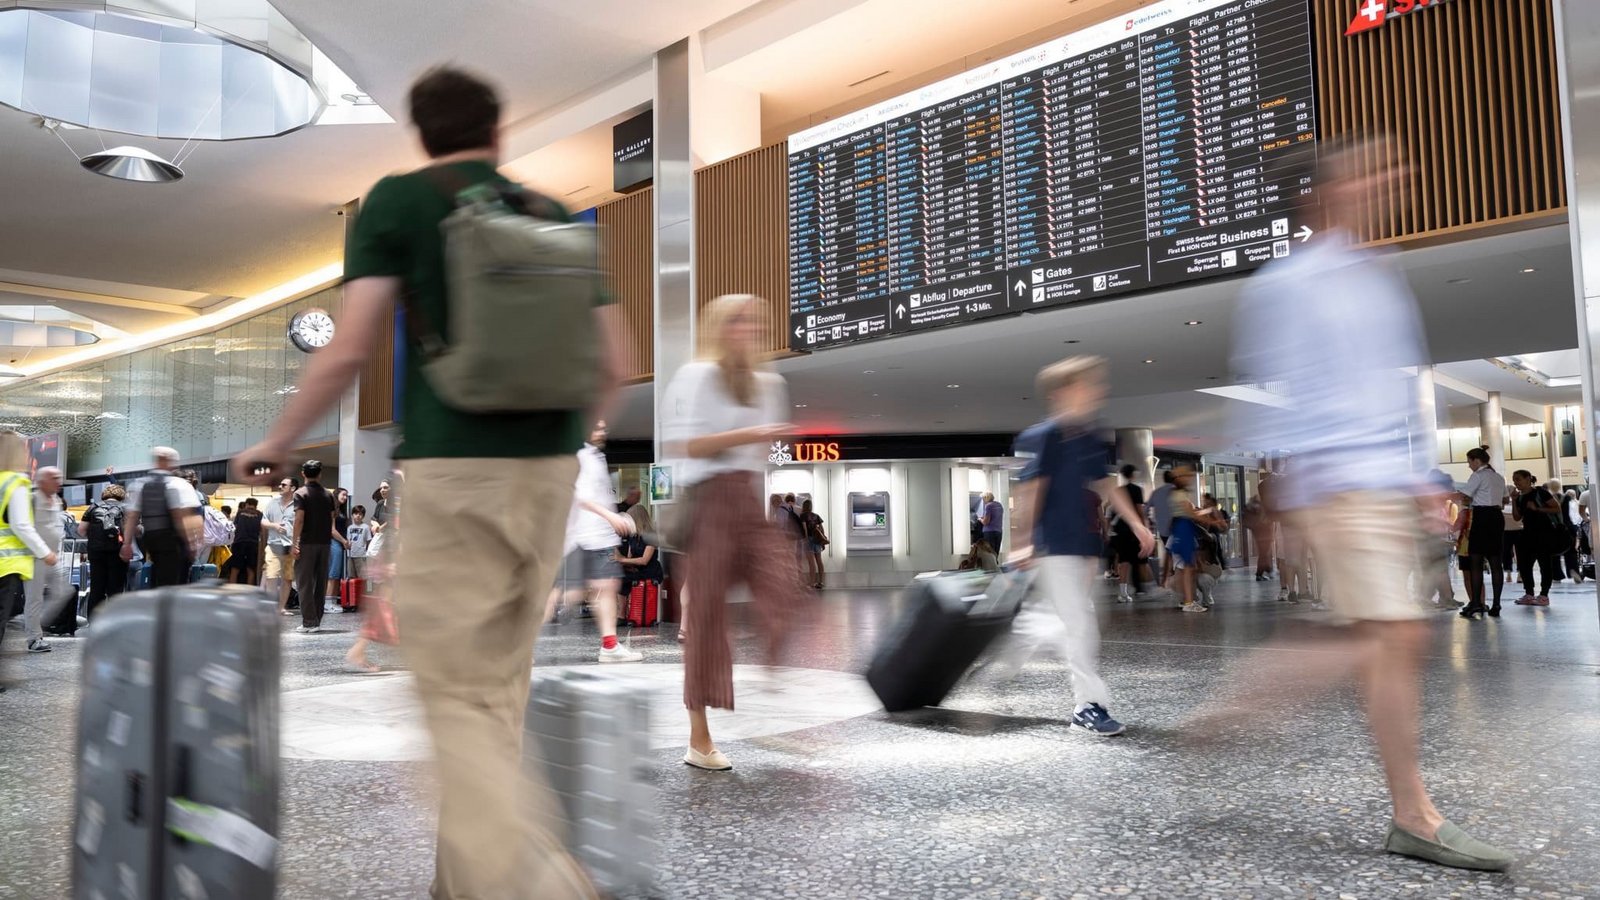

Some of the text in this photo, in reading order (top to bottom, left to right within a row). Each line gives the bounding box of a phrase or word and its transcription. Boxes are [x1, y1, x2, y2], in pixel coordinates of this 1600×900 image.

[1141, 33, 1157, 43] Time
[1189, 15, 1209, 27] Flight
[1214, 4, 1241, 18] Partner
[1003, 81, 1016, 90] Time
[1043, 66, 1060, 77] Flight
[1064, 58, 1086, 69] Partner
[1088, 46, 1116, 61] Check-in
[1121, 41, 1134, 50] Info
[921, 108, 936, 118] Flight
[938, 101, 957, 112] Partner
[959, 92, 982, 105] Check-in
[986, 88, 997, 96] Info
[1261, 97, 1287, 109] Cancelled
[1262, 111, 1274, 119] Gate
[1262, 121, 1275, 130] Gate
[850, 131, 870, 141] Check-in
[1263, 132, 1275, 140] Gate
[626, 138, 651, 152] GALLERY
[1264, 142, 1275, 150] New
[1276, 138, 1290, 147] Time
[1266, 184, 1278, 192] Gate
[1266, 194, 1279, 202] Gate
[1220, 228, 1269, 244] Business
[1176, 237, 1194, 246] SWISS
[1187, 243, 1200, 251] HON
[1244, 246, 1270, 255] Gruppen
[1194, 256, 1218, 265] Sperrgut
[1249, 253, 1270, 262] Groups
[1046, 267, 1072, 278] Gates
[953, 283, 992, 297] Departure
[922, 292, 946, 303] Abflug
[965, 303, 992, 313] 1-3 Min.
[817, 313, 846, 324] Economy
[795, 443, 840, 462] UBS
